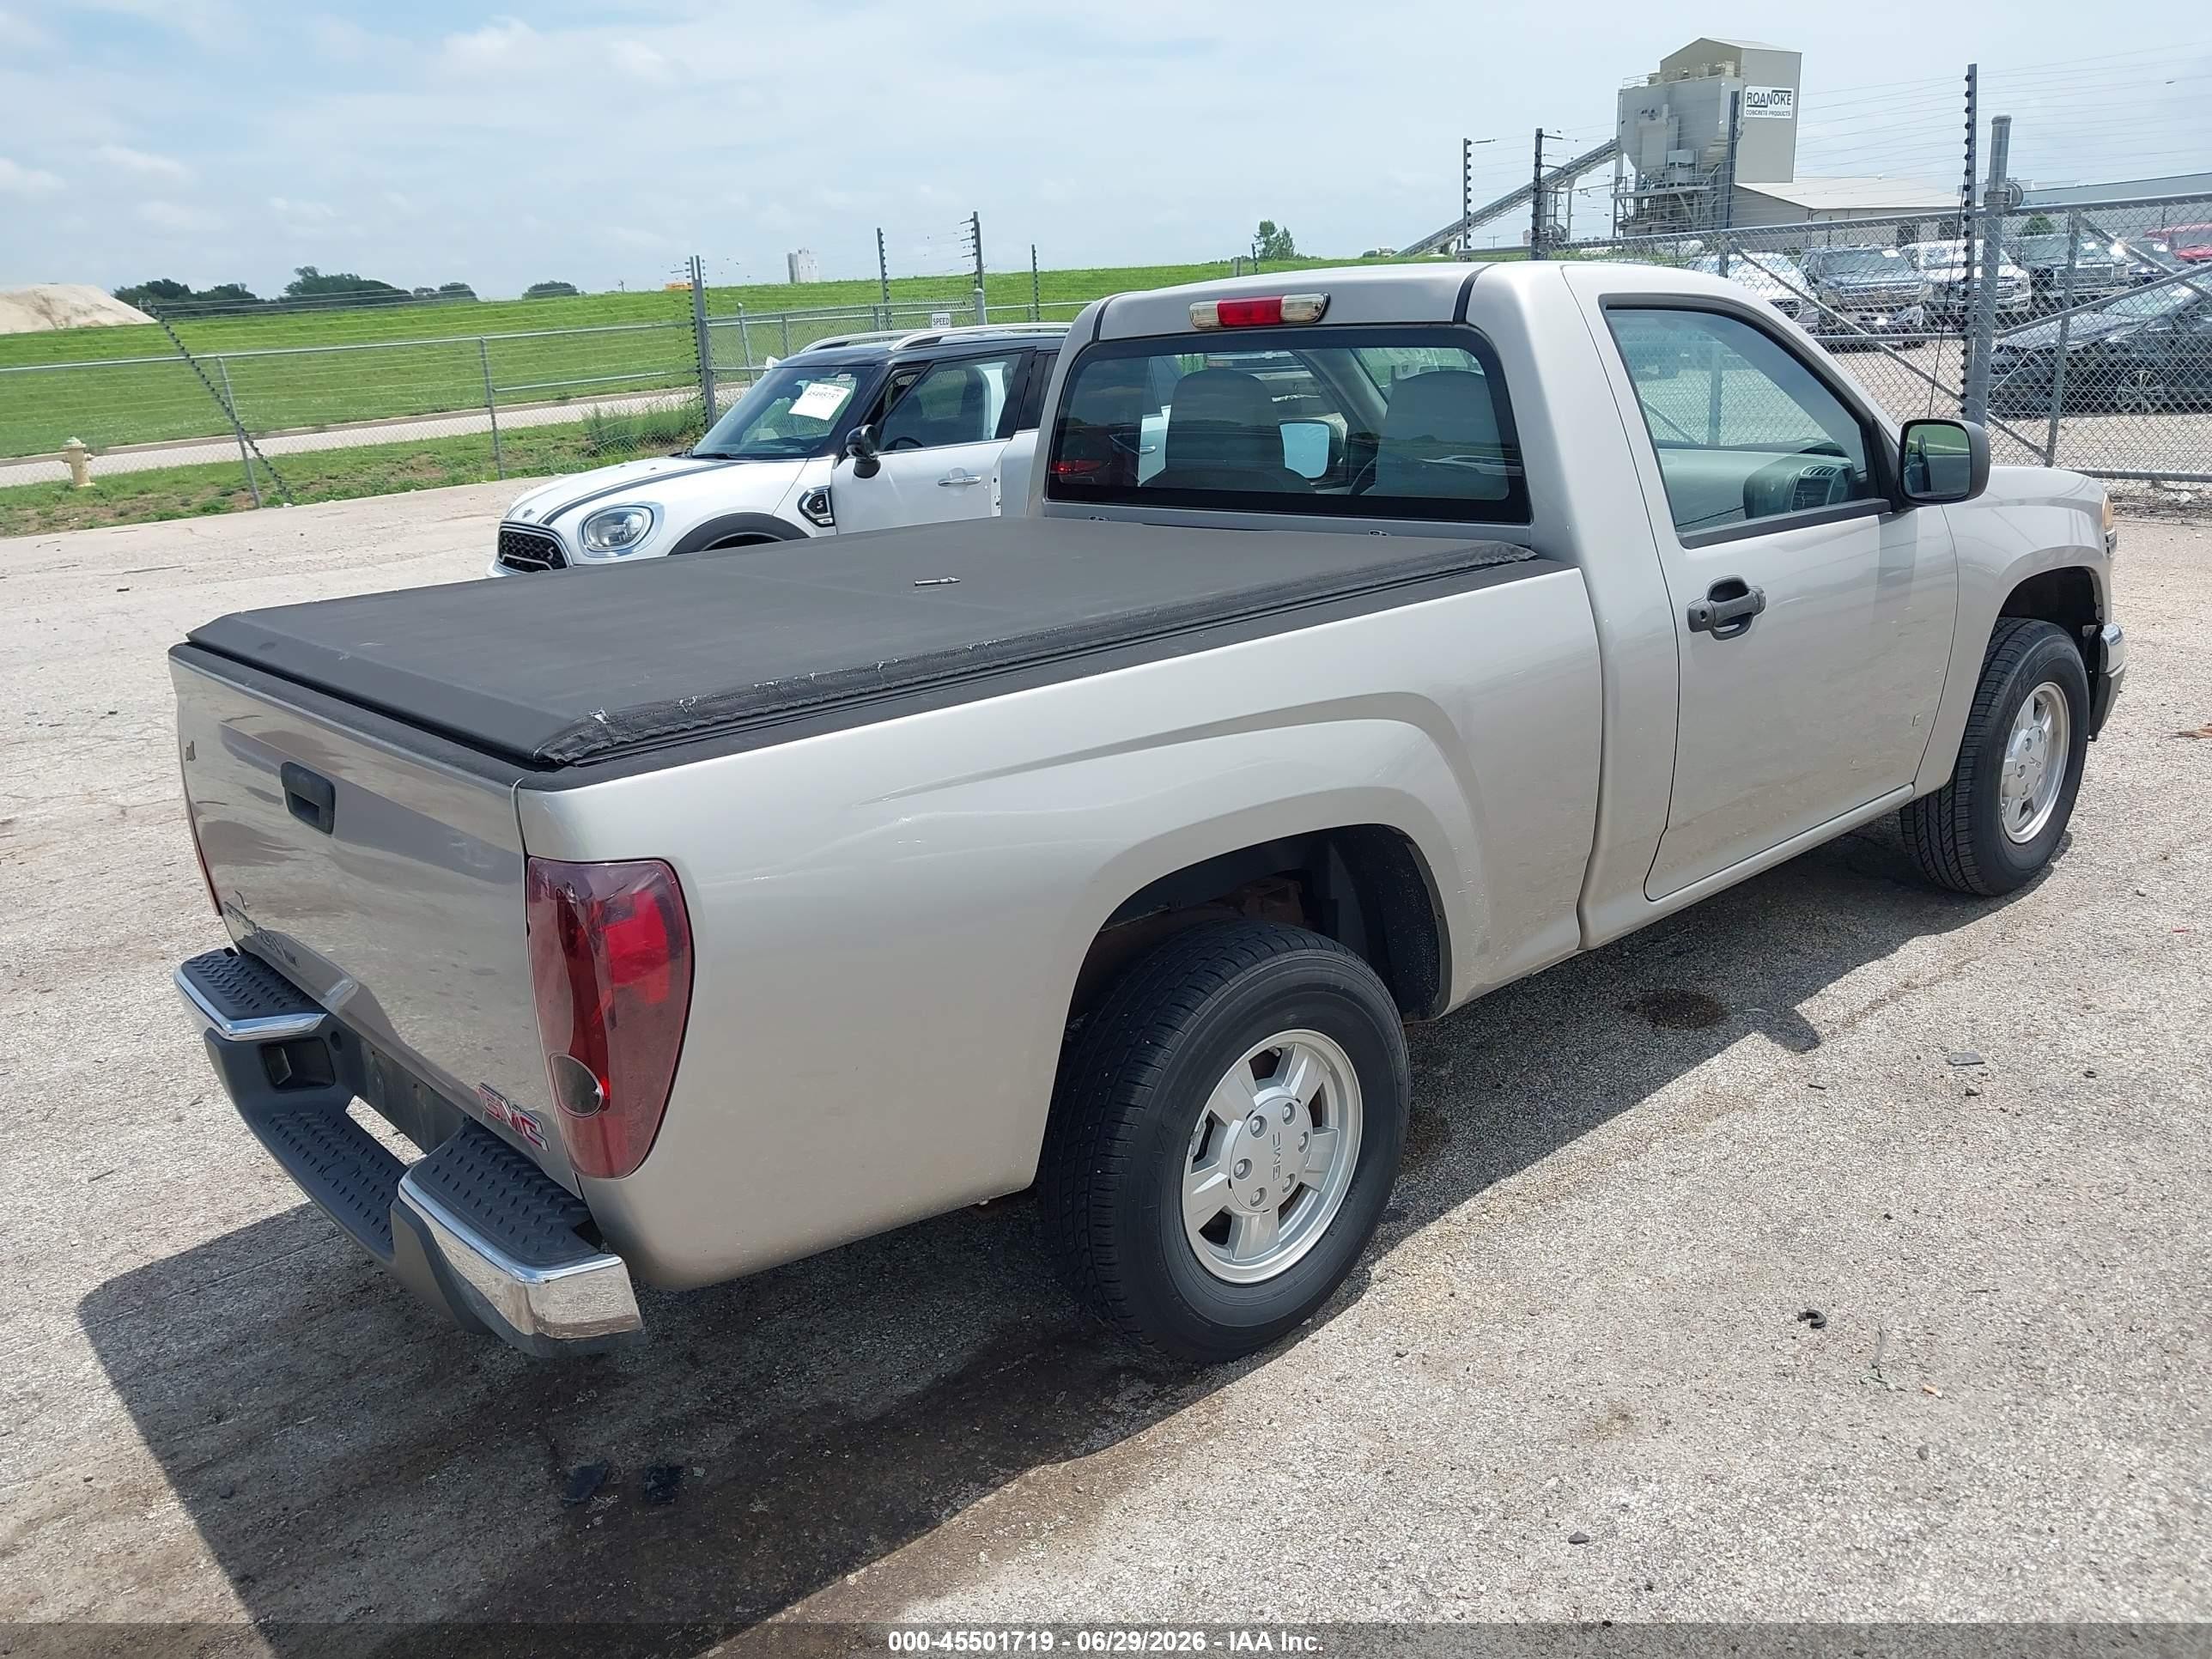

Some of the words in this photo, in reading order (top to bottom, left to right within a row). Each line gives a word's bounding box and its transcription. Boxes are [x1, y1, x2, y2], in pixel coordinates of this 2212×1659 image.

[1746, 91, 1792, 106] ROANOKE
[933, 317, 950, 325] SPEED
[477, 1083, 550, 1152] GMC
[1272, 1132, 1281, 1182] GMC
